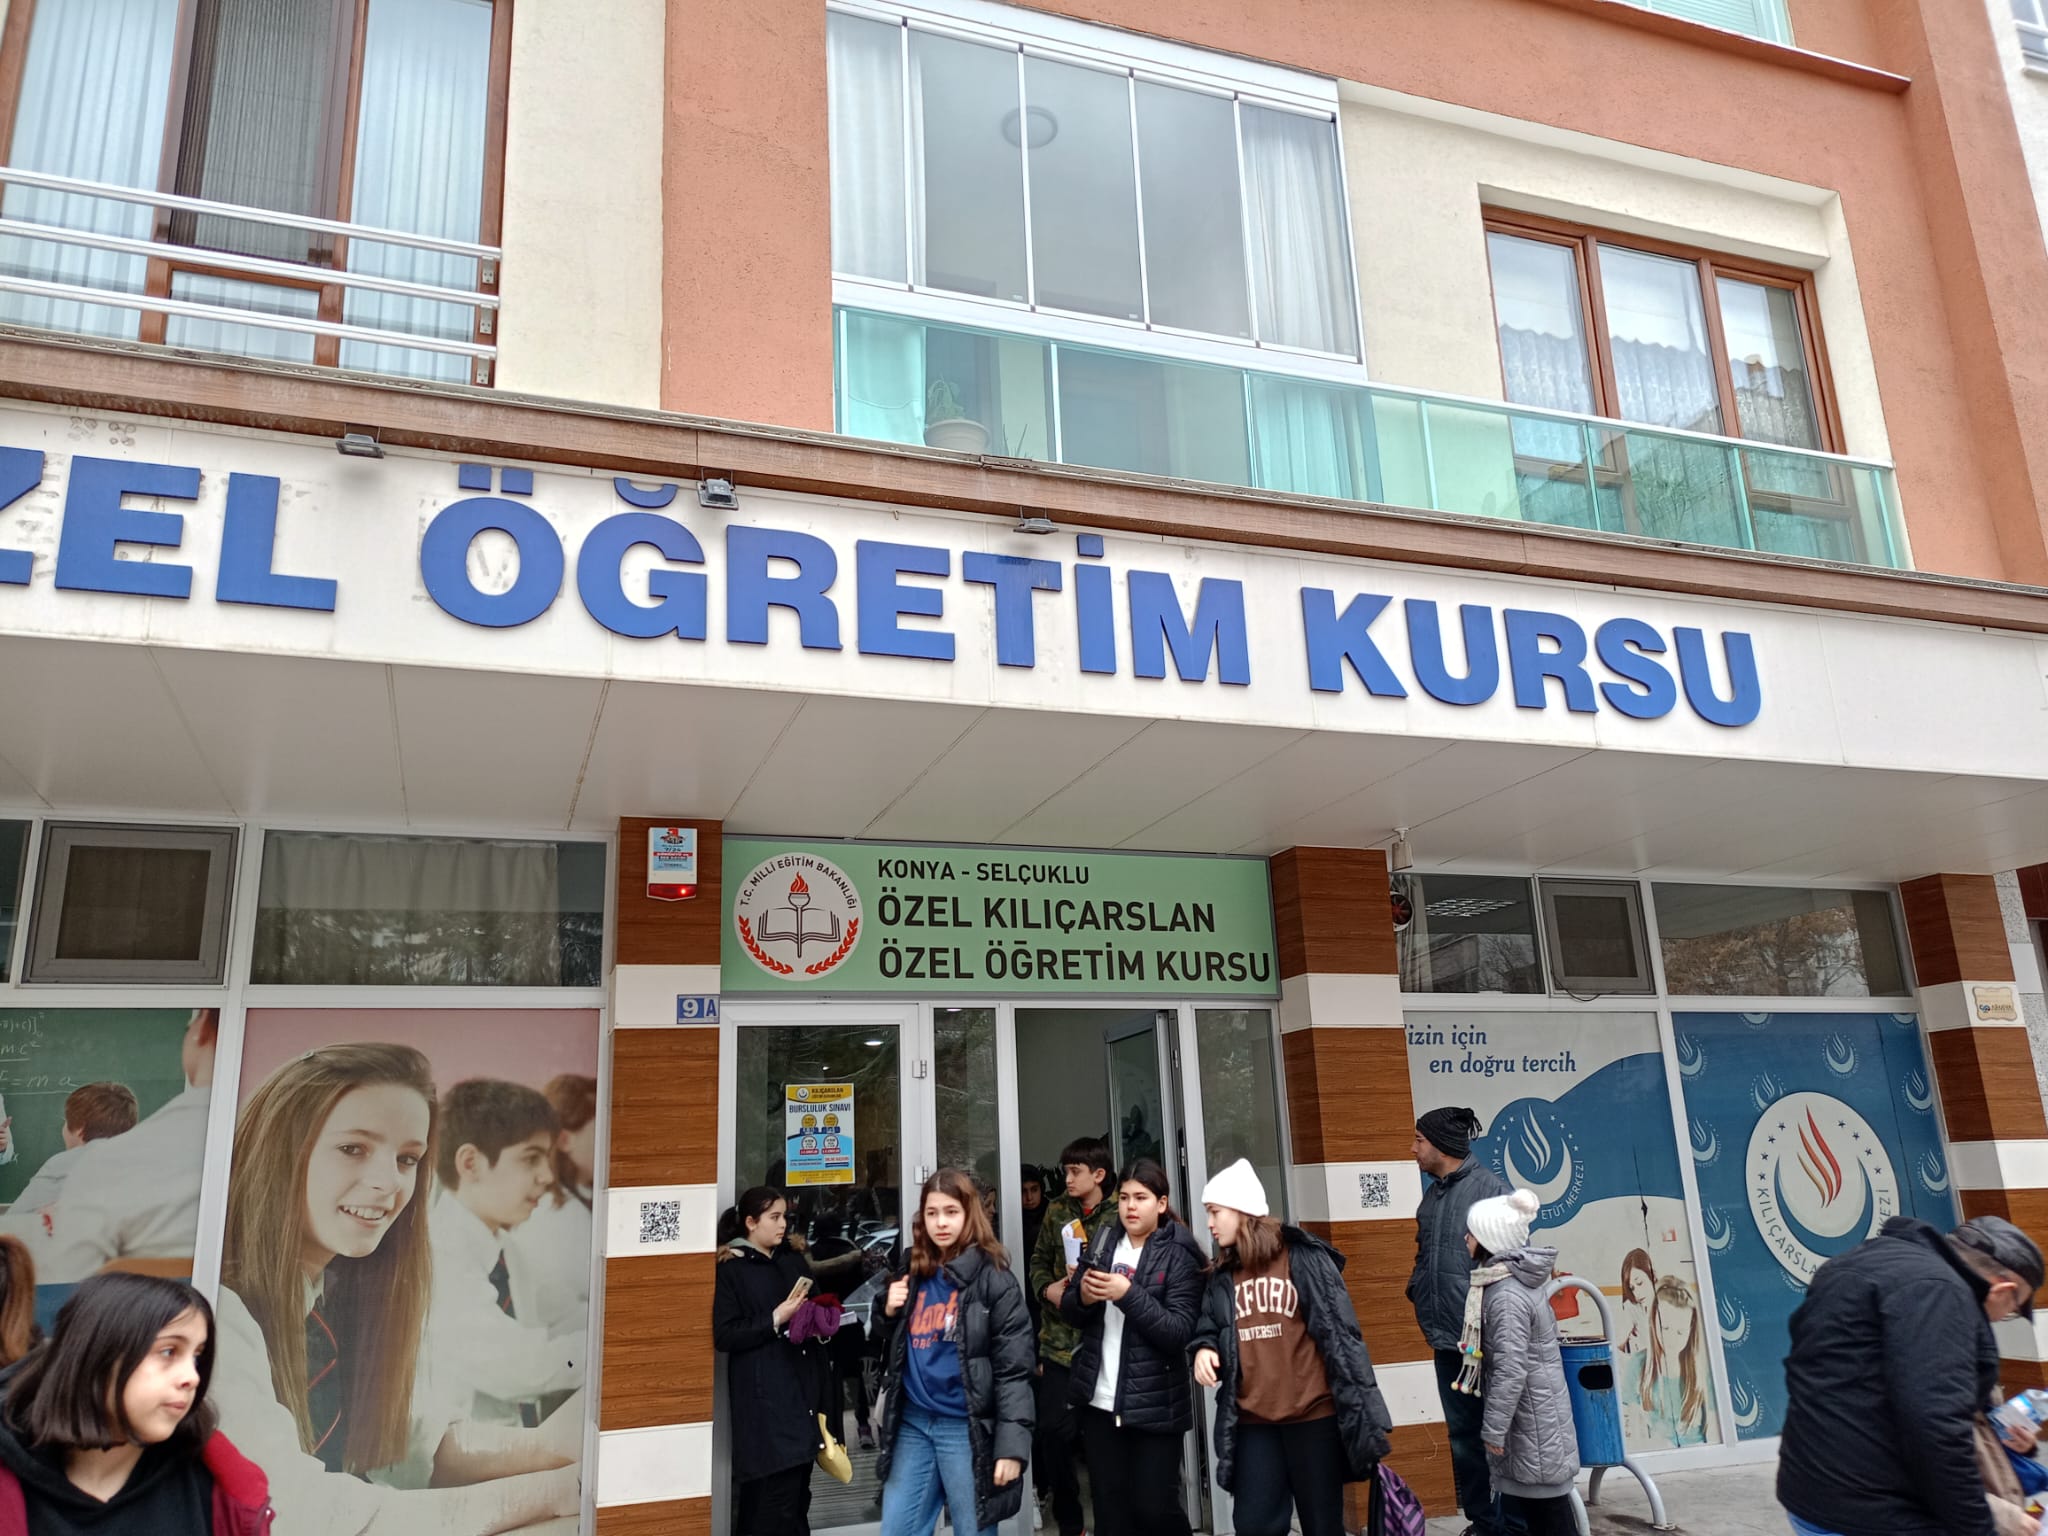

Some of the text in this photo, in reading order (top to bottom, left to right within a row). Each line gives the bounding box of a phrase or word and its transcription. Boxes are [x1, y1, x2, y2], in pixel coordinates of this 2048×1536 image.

[420, 464, 1251, 686] ÖĞRETİM
[1301, 587, 1762, 727] KURSU
[750, 861, 776, 887] MİLLİ
[777, 855, 814, 869] EĞİTİM
[816, 862, 857, 909] BAKANLIĞI
[878, 858, 956, 881] KONYA
[976, 862, 1089, 886] SELÇUKLU
[878, 886, 1215, 934] ÖZEL KILIÇARSLAN
[879, 937, 1270, 983] ÖZEL ÖĞRETİM KURSU
[1404, 1024, 1487, 1050] izin için
[1429, 1051, 1577, 1077] en doğru tercih
[1756, 1187, 1818, 1276] KILIÇARSLA
